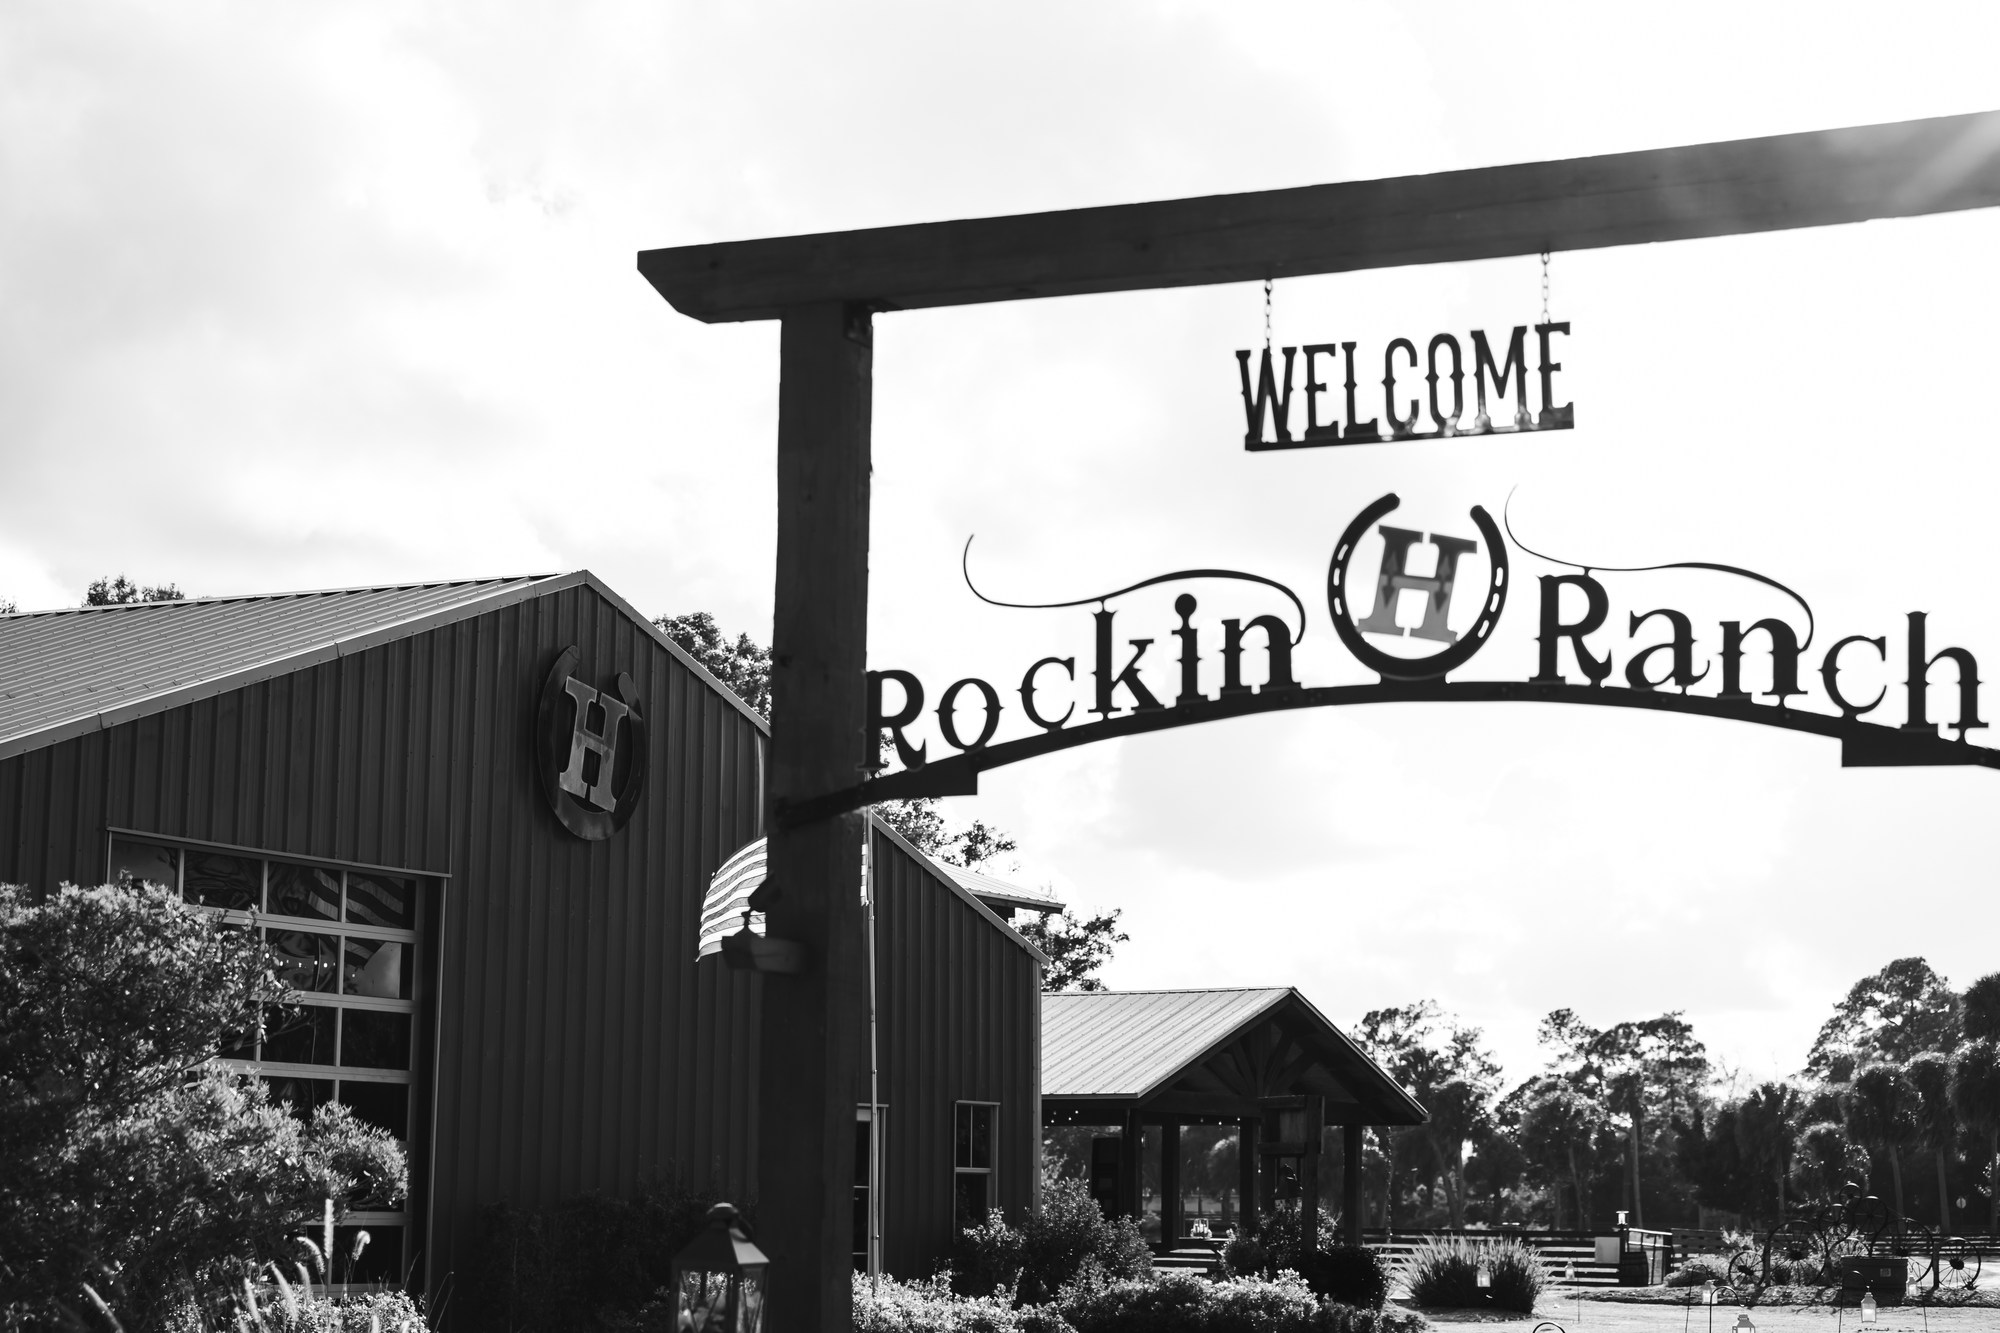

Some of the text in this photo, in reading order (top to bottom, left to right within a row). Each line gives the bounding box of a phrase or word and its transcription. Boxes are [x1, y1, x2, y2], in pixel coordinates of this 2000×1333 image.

[1235, 322, 1574, 448] WELCOME
[857, 524, 1989, 771] Rockin H Ranch
[559, 675, 629, 813] H
